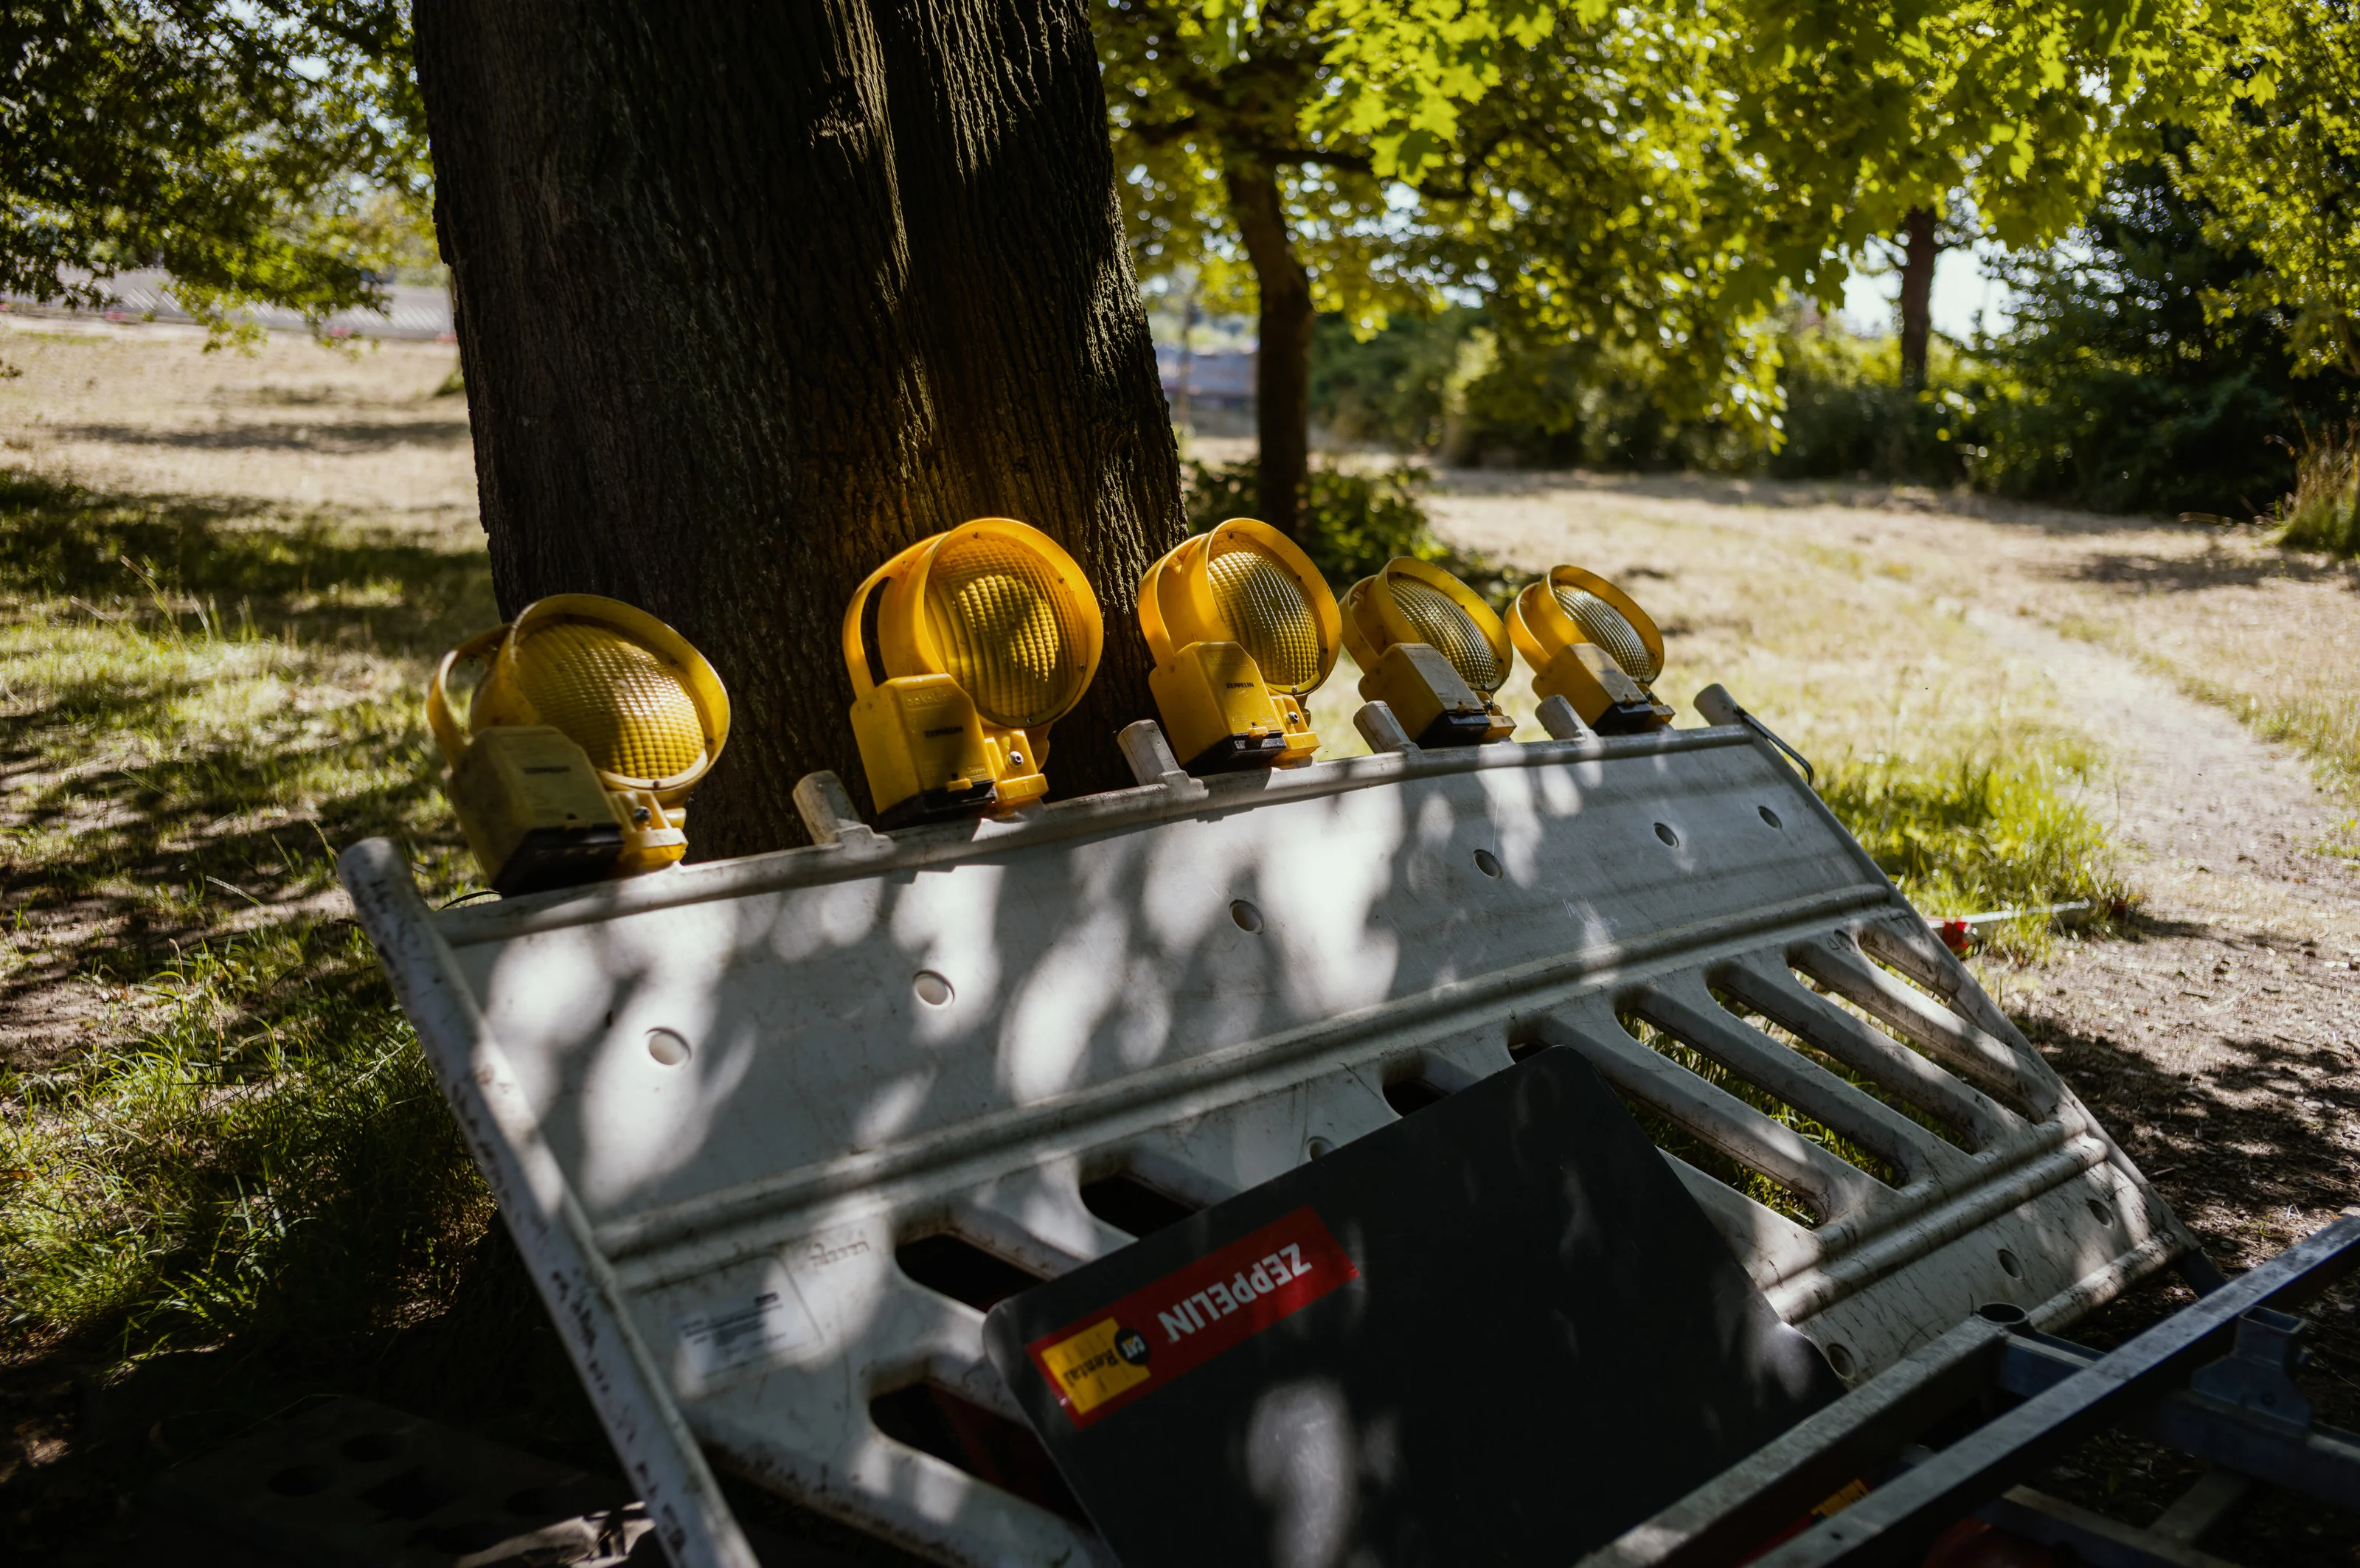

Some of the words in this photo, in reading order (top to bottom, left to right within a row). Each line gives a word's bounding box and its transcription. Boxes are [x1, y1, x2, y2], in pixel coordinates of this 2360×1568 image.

[1157, 1242, 1312, 1342] ZEPPELIN
[1122, 1334, 1145, 1359] CAT
[1064, 1347, 1120, 1387] Rental
